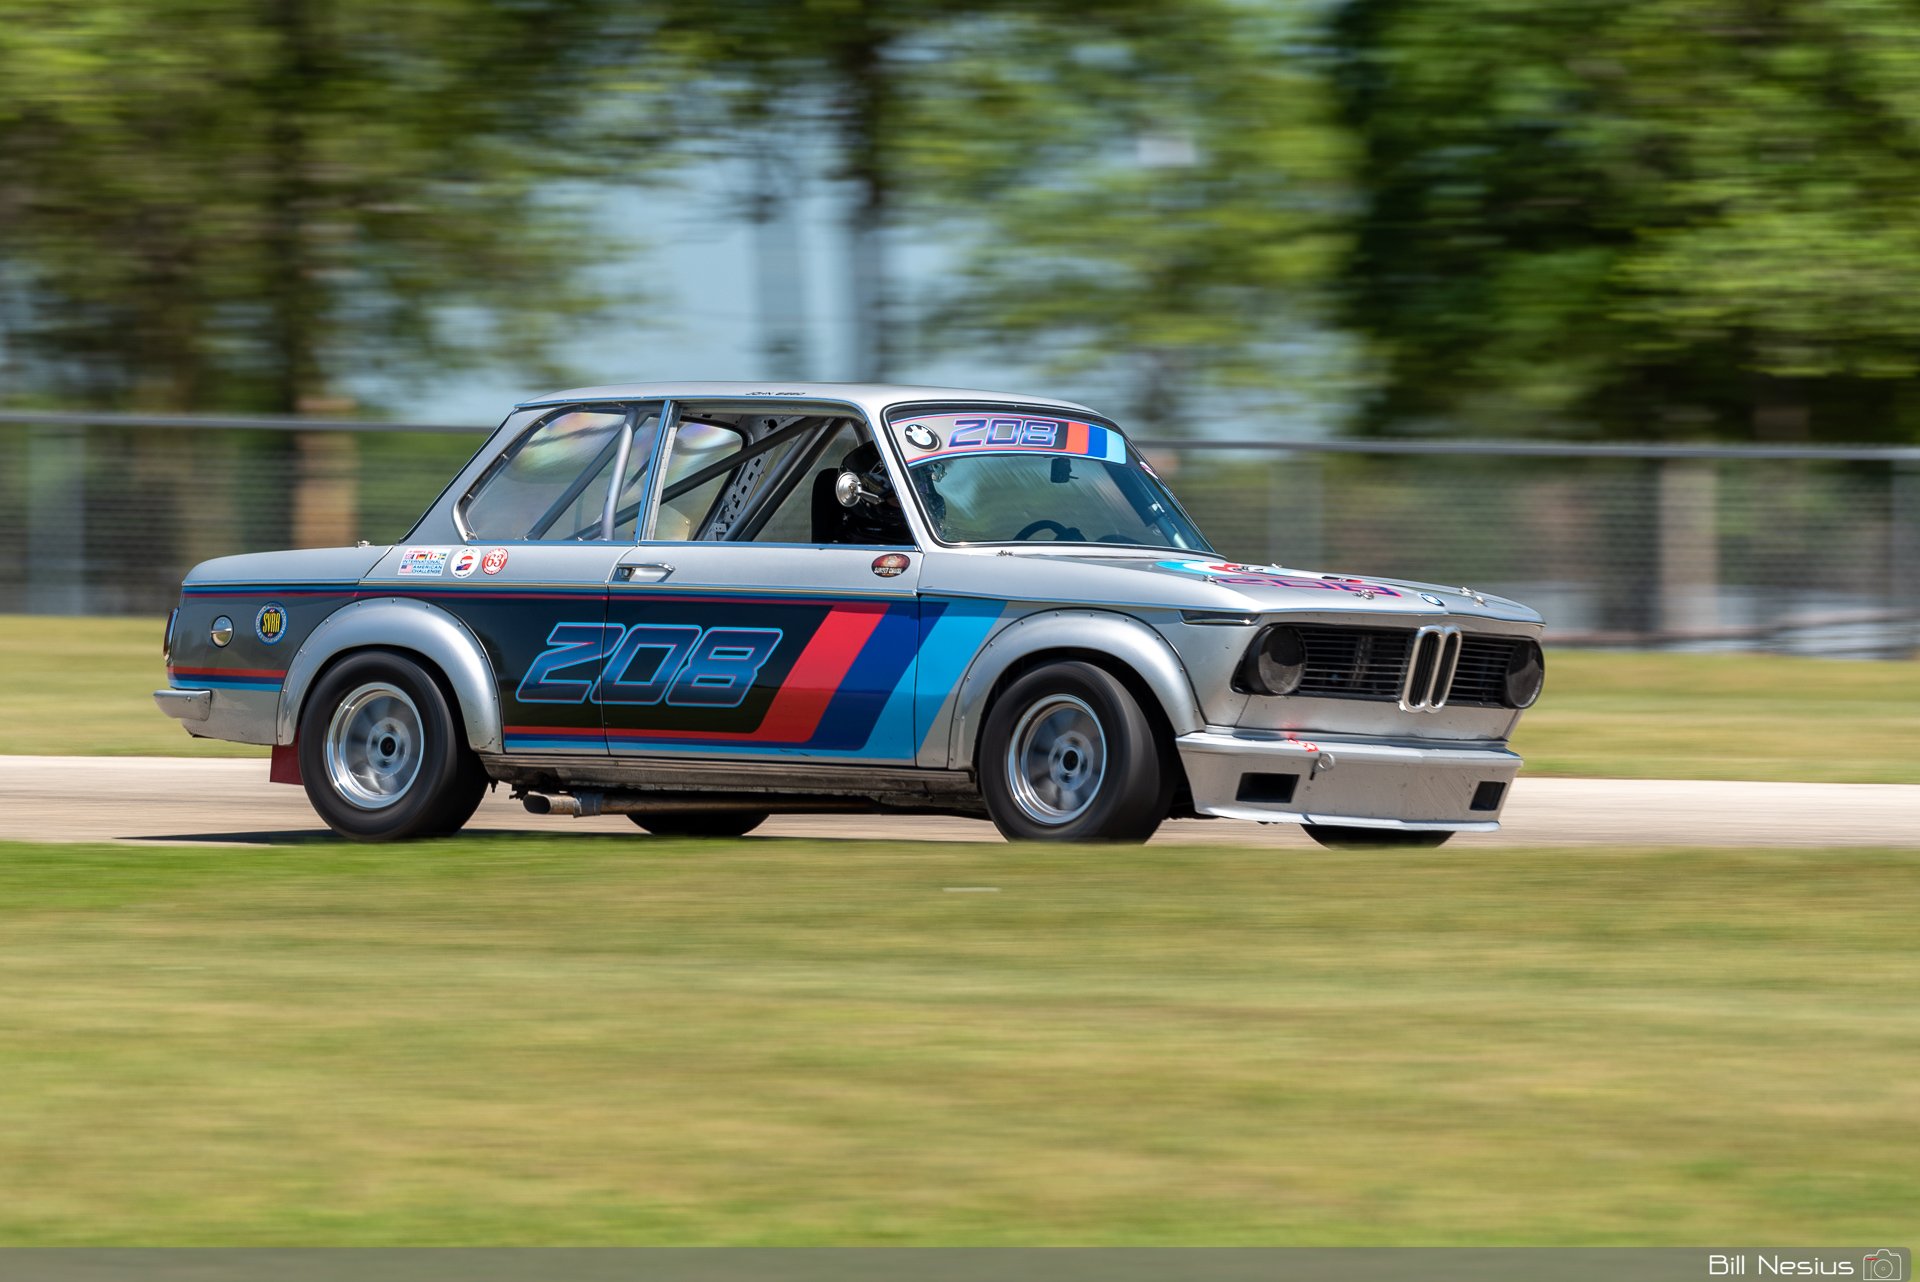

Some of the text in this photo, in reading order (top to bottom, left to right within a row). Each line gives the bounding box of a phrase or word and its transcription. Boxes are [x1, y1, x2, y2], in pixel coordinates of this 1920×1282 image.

[948, 417, 1058, 448] 208
[486, 553, 504, 568] 63
[262, 612, 281, 633] SVRA
[515, 622, 783, 707] 208
